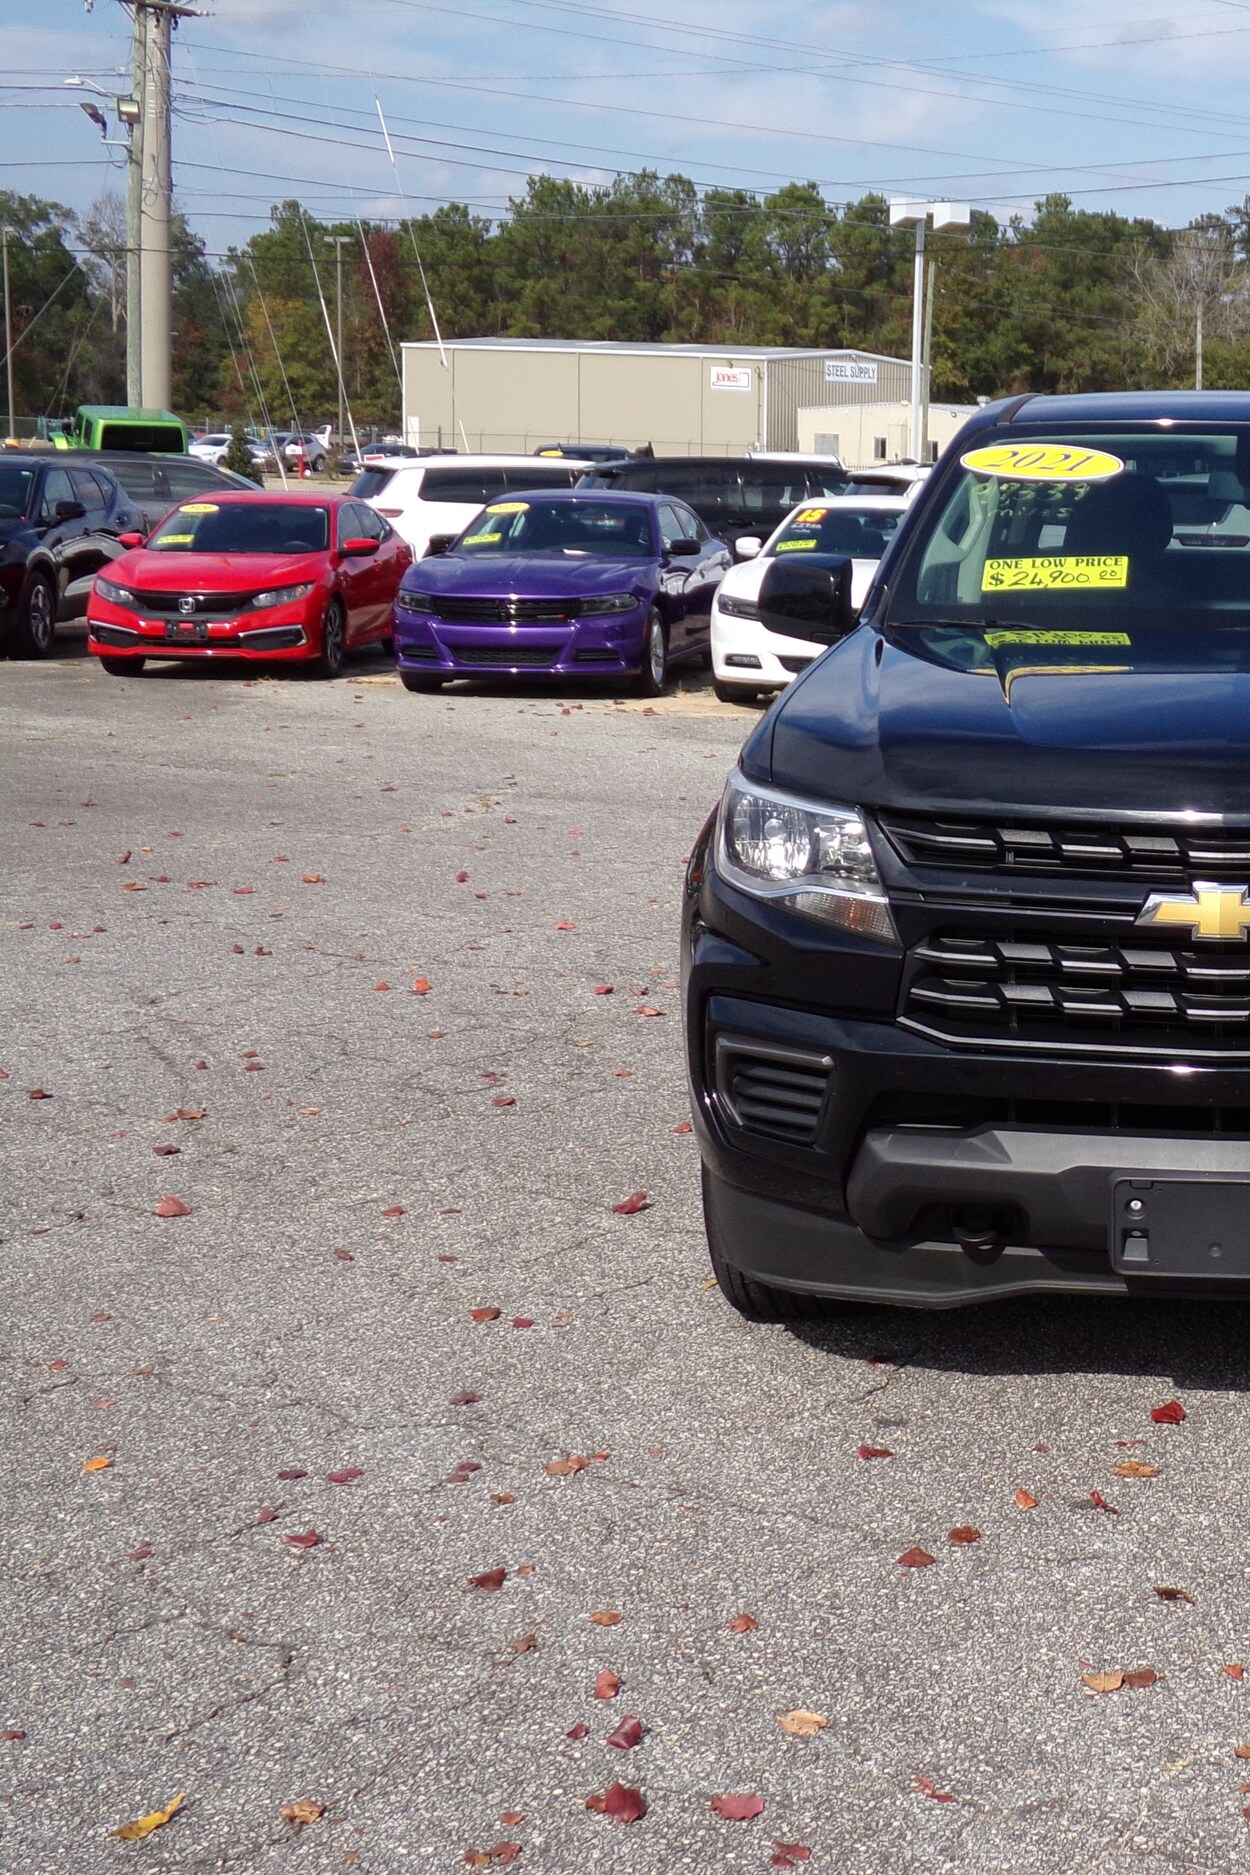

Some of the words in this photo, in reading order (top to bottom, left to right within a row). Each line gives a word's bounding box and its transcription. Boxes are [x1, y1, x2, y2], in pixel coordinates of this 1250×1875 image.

[826, 364, 849, 378] STEEL
[849, 364, 877, 380] SUPPLY
[981, 450, 1096, 472] 2021
[988, 559, 1024, 571] ONE
[1031, 558, 1068, 569] LOW
[1074, 556, 1124, 568] PRICE
